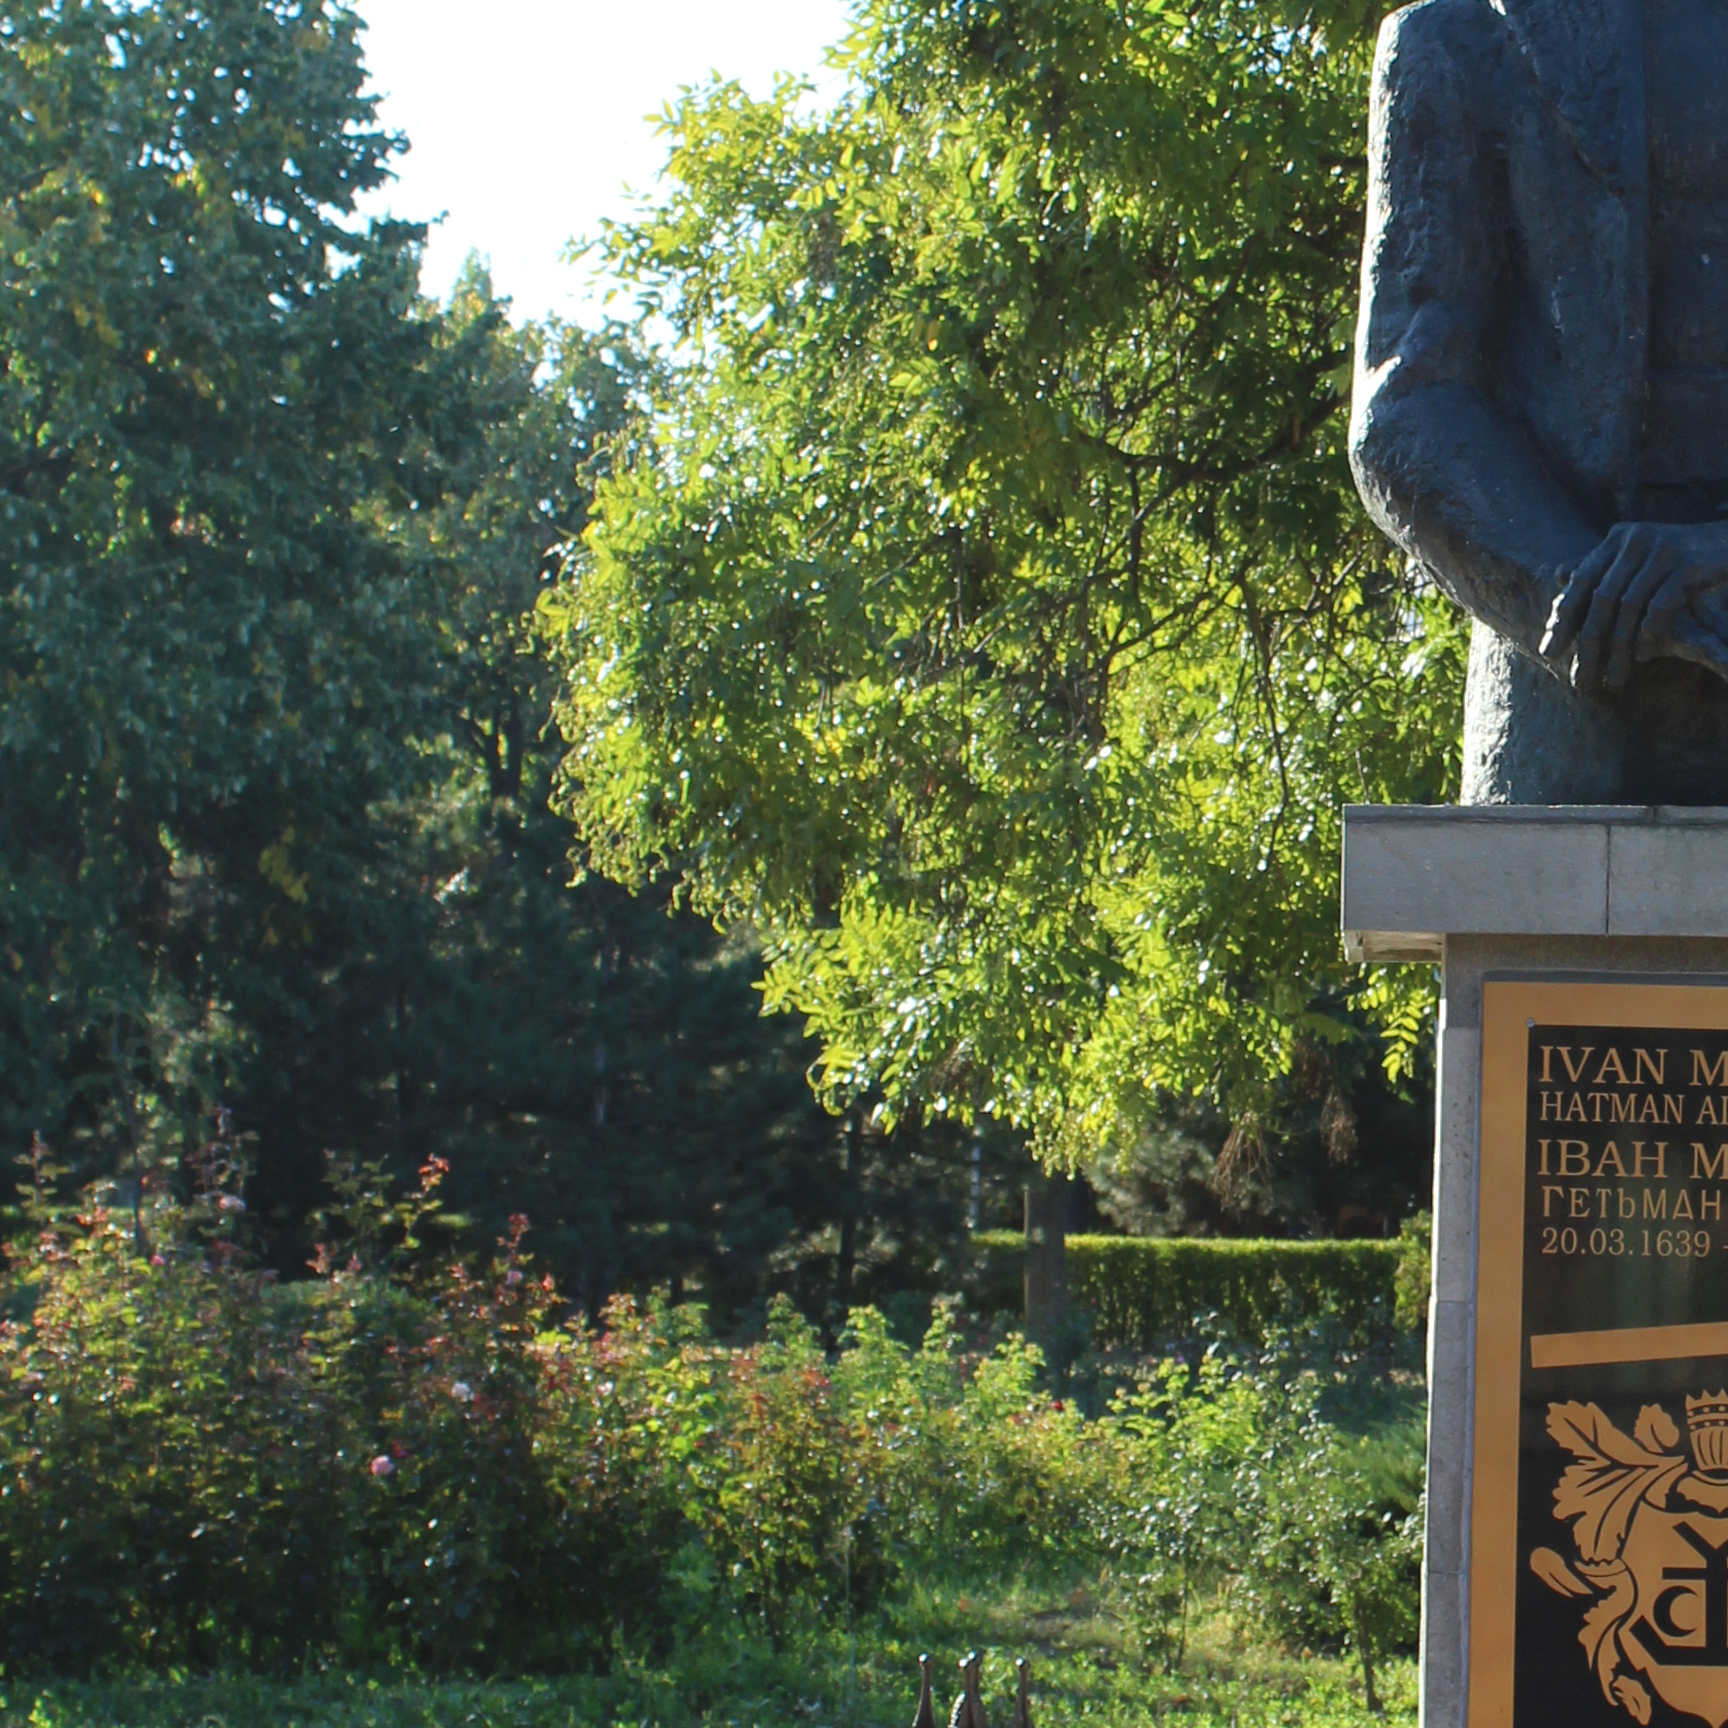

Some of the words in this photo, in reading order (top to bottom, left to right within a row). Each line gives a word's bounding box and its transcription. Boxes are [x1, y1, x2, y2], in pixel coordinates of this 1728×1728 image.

[1538, 1045, 1669, 1086] IVAN
[1538, 1090, 1686, 1125] HATMAN
[1536, 1138, 1669, 1179] ІВАН
[1541, 1227, 1712, 1258] 20.03.1639
